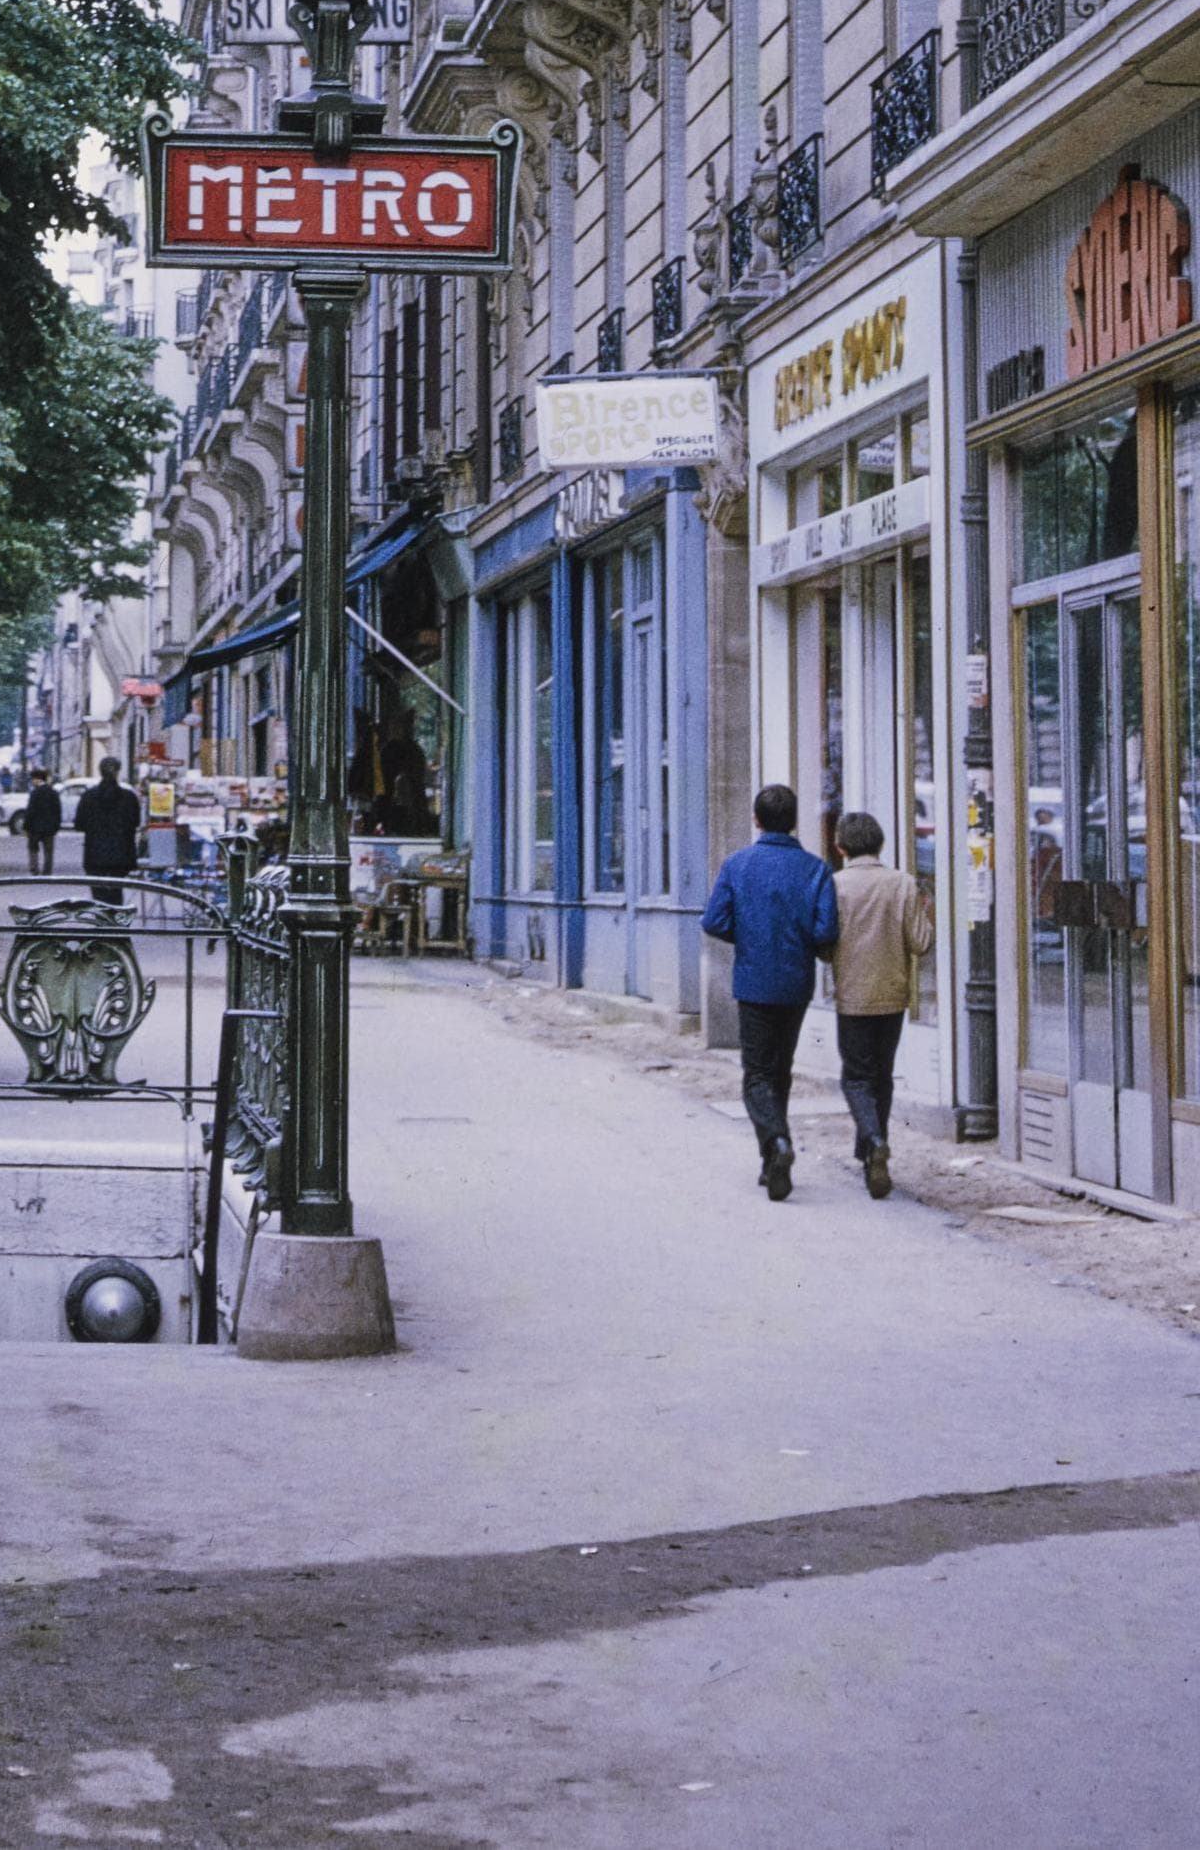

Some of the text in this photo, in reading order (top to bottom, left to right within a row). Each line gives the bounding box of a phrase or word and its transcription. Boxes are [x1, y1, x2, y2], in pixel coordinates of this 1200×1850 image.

[188, 164, 473, 237] METRO
[550, 389, 709, 429] Birence
[652, 448, 716, 459] PANTALONS
[871, 494, 897, 537] PLAGE
